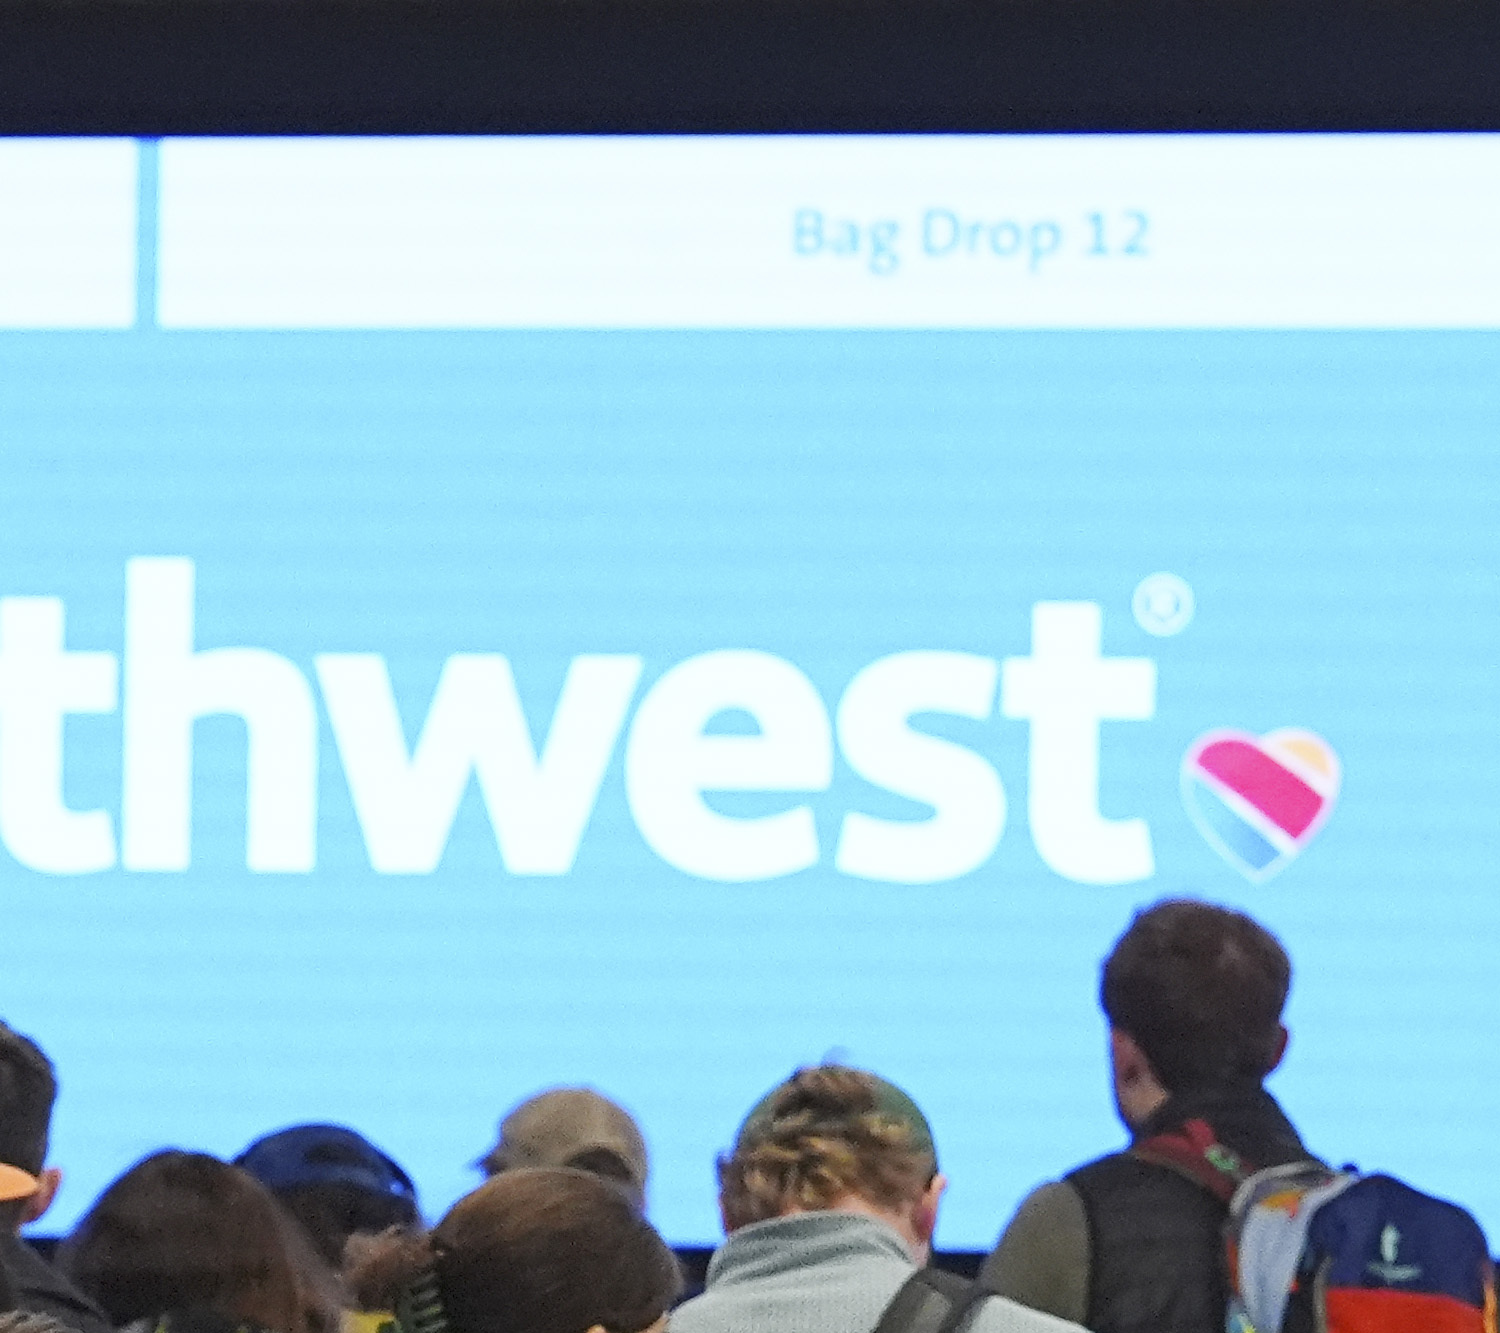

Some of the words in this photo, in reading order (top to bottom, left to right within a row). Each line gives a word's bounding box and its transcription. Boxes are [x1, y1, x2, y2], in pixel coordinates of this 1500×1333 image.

[792, 207, 902, 277] Bag
[920, 205, 1065, 274] Drop
[1085, 208, 1152, 258] 12
